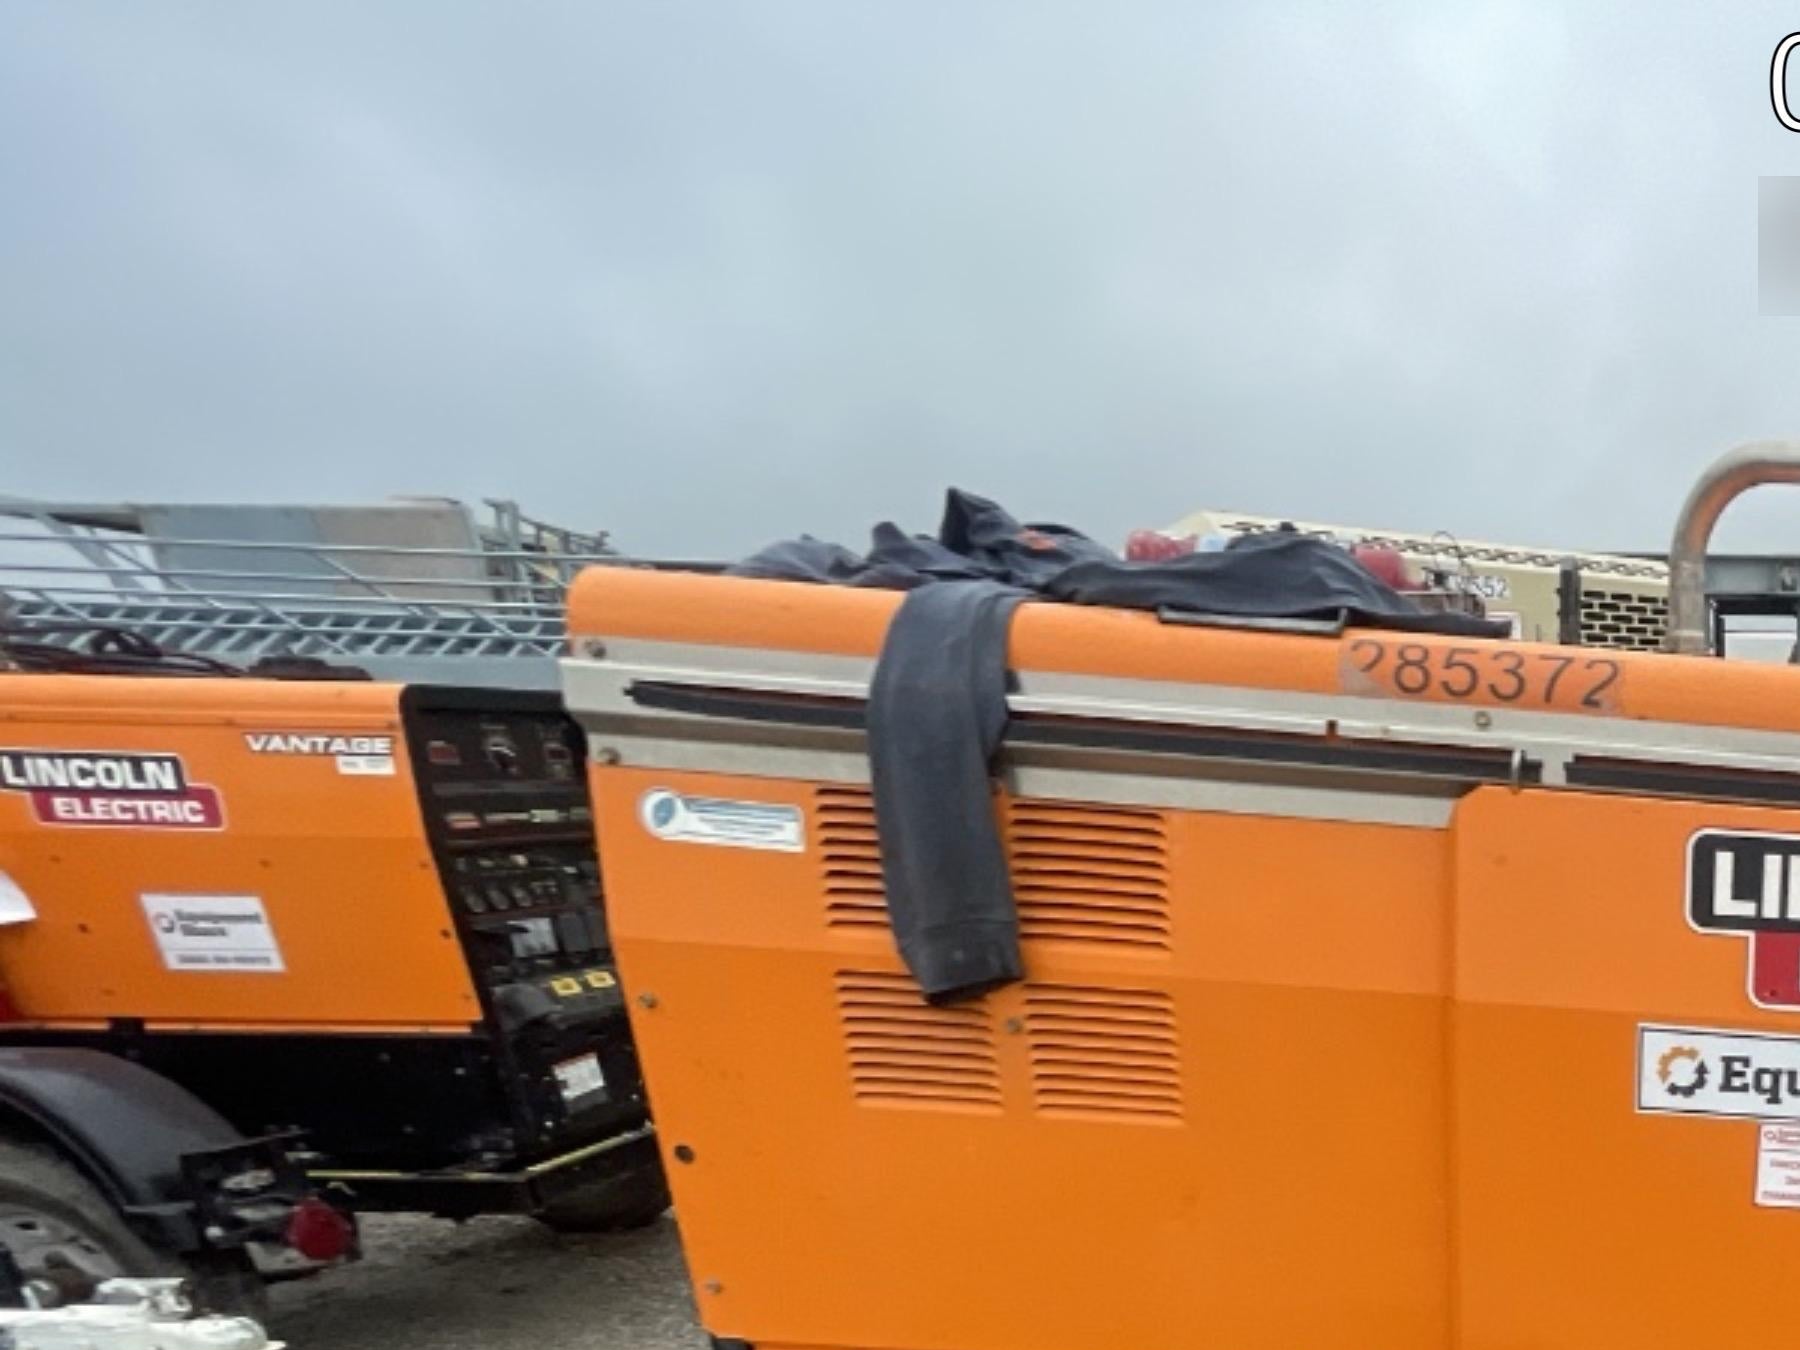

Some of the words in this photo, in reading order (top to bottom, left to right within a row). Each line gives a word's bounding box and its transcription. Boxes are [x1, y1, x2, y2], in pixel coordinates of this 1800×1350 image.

[245, 734, 393, 755] VANTAGE
[1, 754, 178, 791] LINCOLN
[51, 796, 206, 825] ELECTRIC
